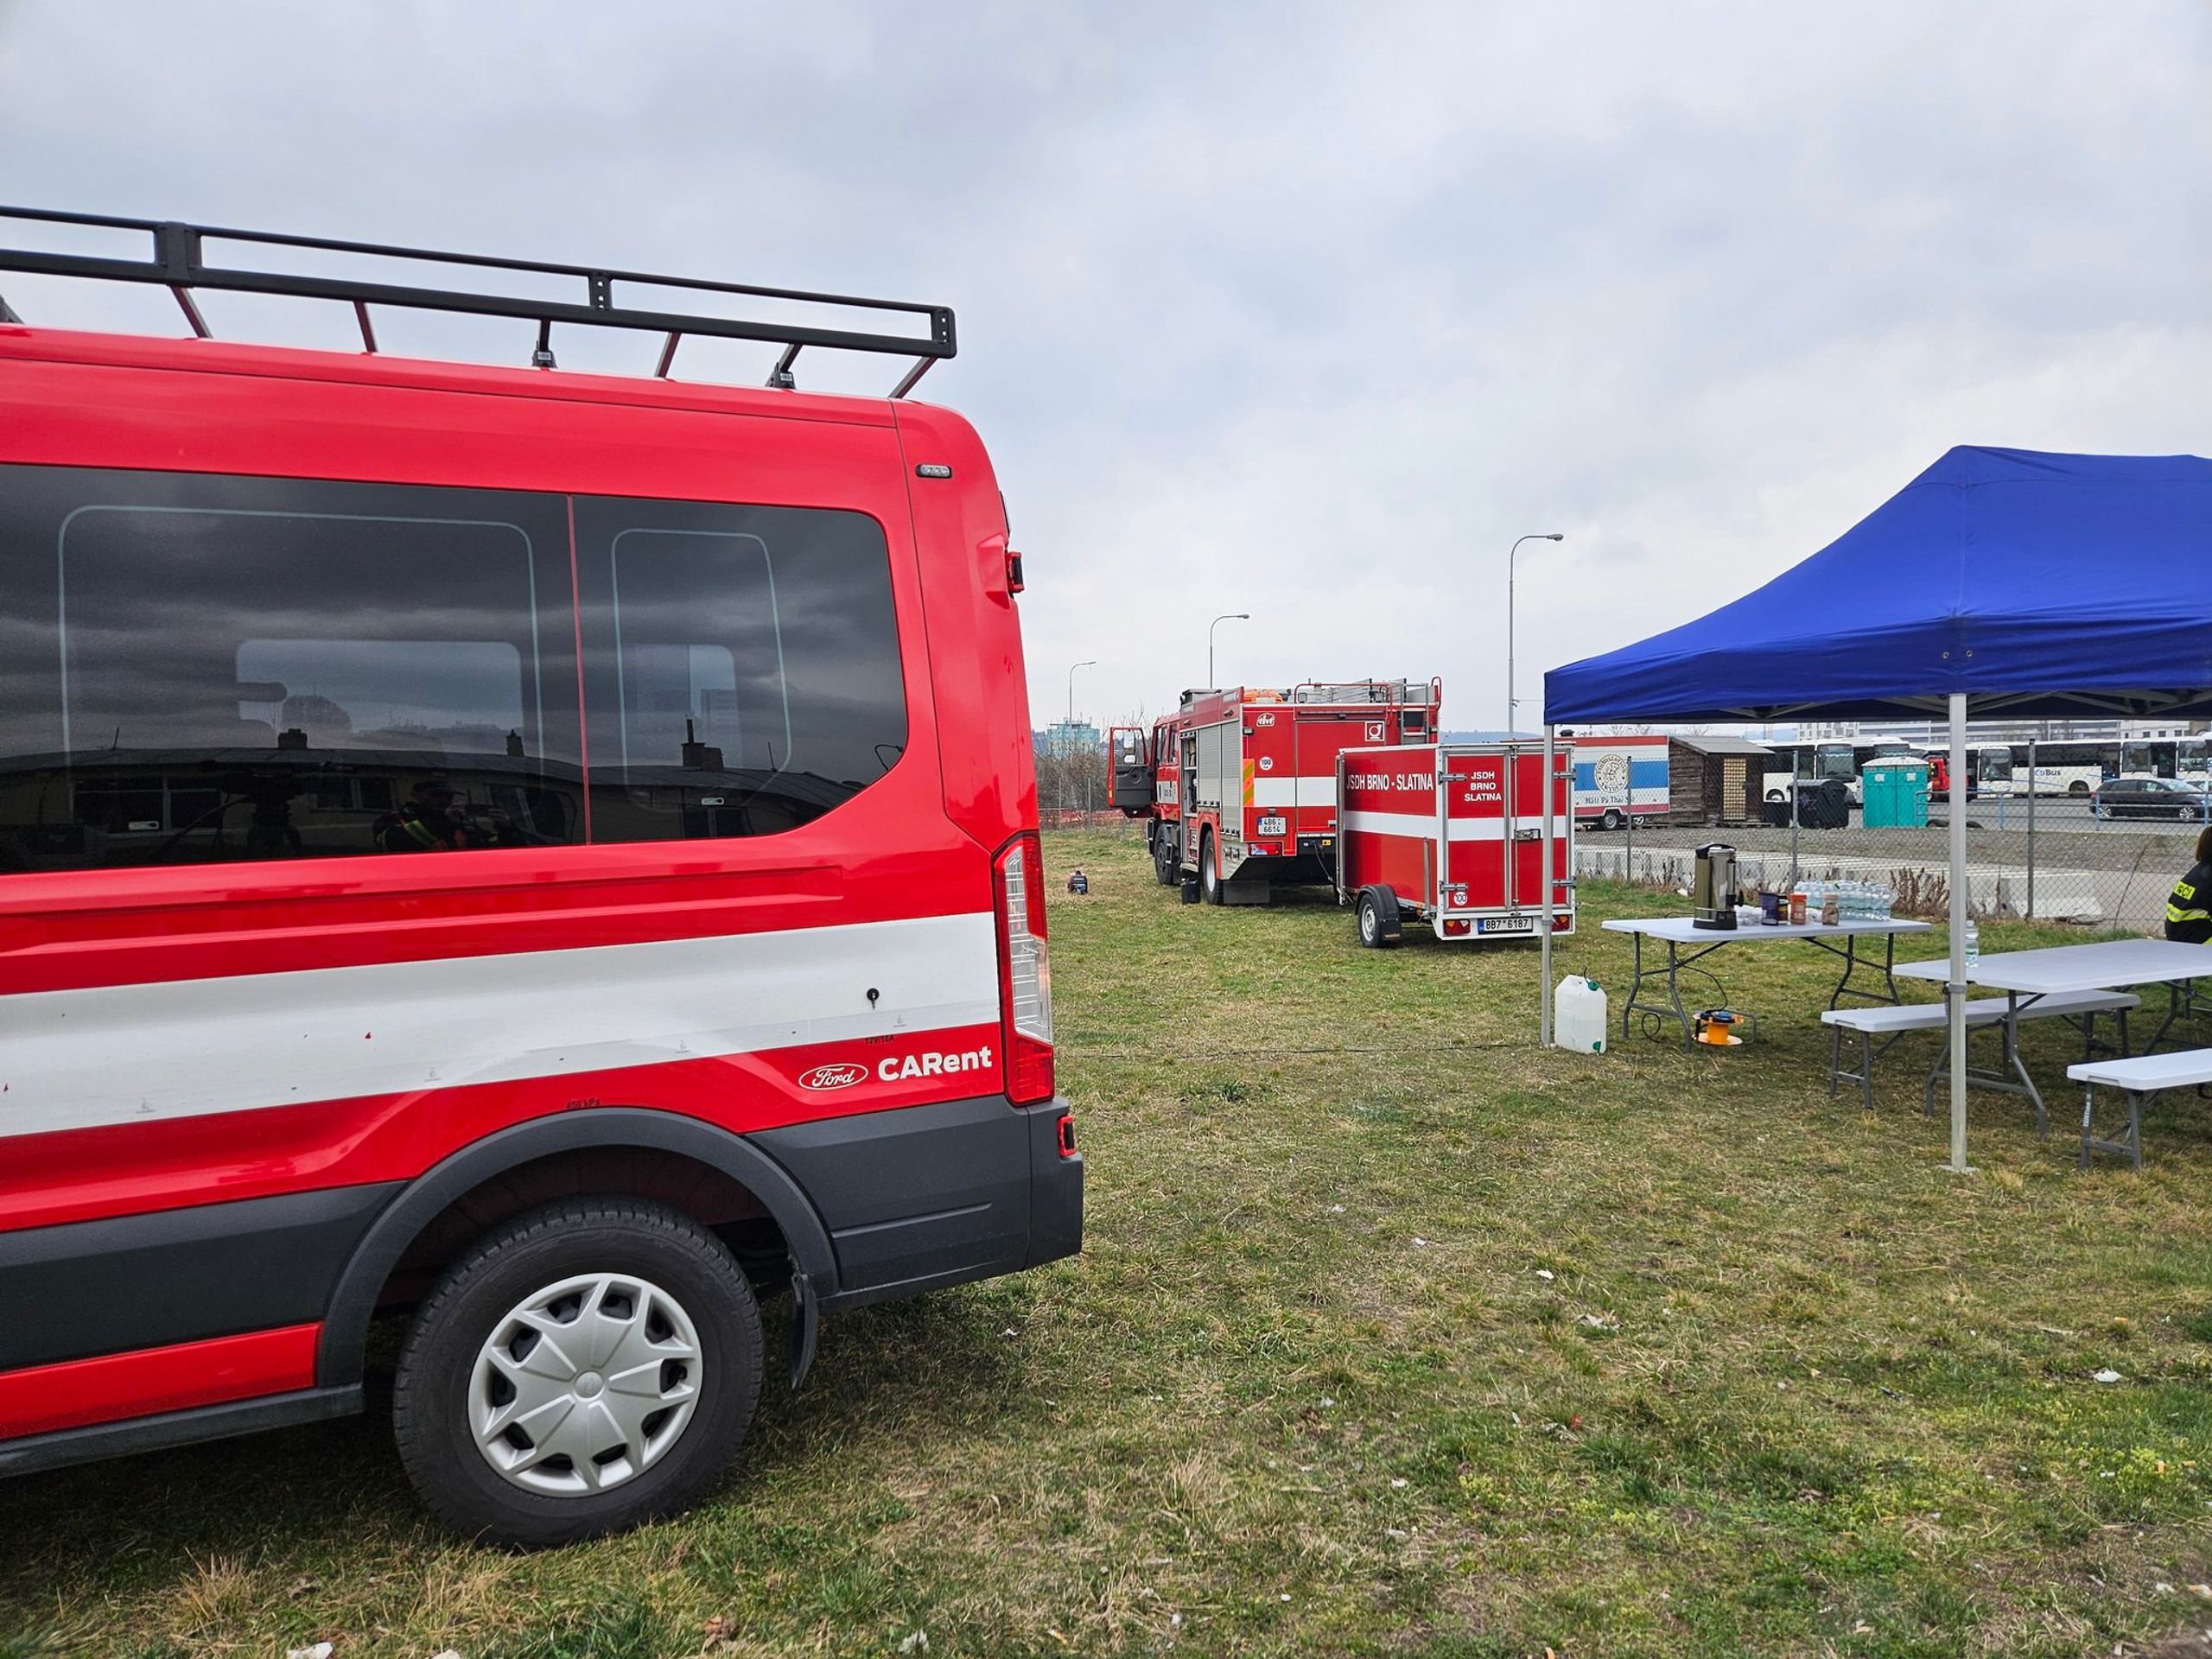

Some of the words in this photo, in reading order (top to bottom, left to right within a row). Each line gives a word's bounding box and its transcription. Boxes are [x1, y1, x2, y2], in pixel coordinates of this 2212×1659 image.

[1471, 772, 1495, 780] JSDH
[1346, 774, 1365, 791] JSDH
[1367, 773, 1390, 791] BRNO
[1396, 773, 1433, 791] SLATINA
[1470, 782, 1497, 791] BRNO
[1464, 793, 1502, 802] SLATINA
[1455, 893, 1466, 903] 100
[1507, 918, 1529, 929] 6187
[810, 1065, 856, 1089] Ford
[878, 1046, 992, 1082] CARent
